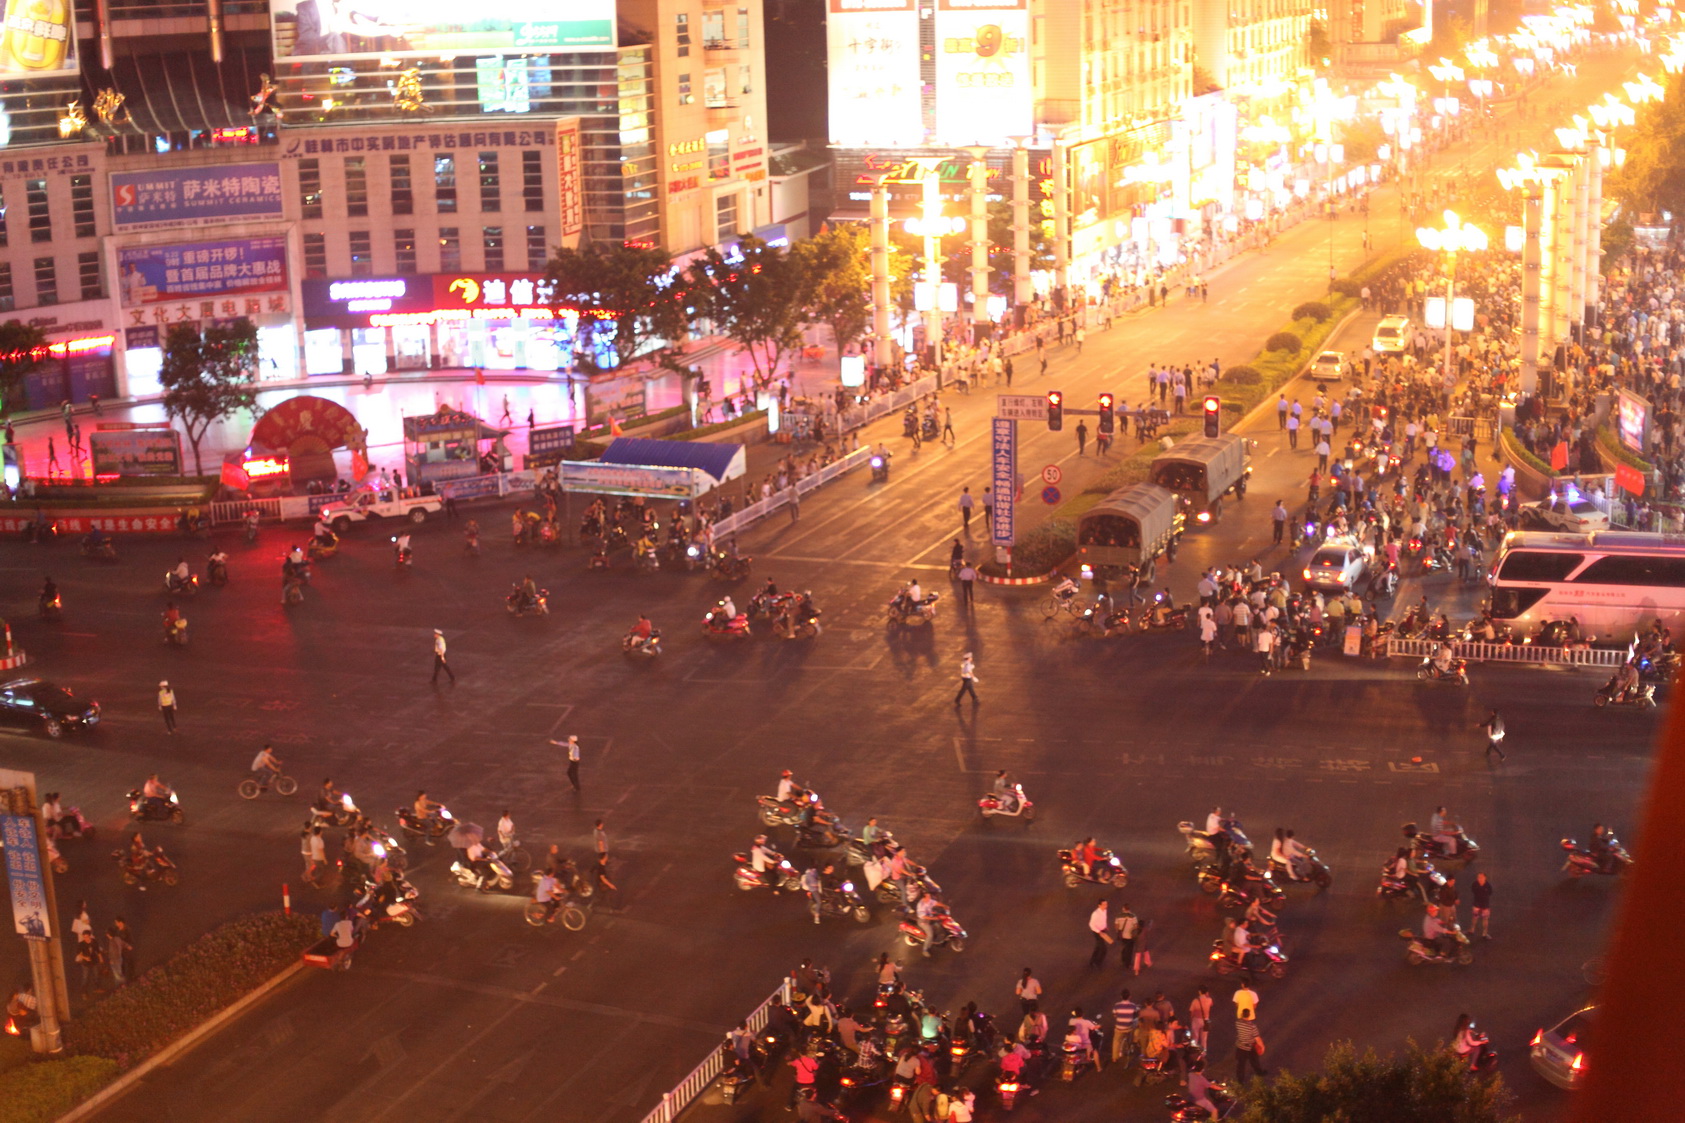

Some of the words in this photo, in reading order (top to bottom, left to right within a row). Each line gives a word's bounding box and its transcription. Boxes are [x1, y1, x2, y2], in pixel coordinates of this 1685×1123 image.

[182, 175, 281, 200] 萨米特陶瓷
[138, 190, 177, 206] 萨米特
[183, 198, 224, 207] SUMMIT
[229, 194, 281, 204] CERAMICS
[165, 259, 281, 283] 暨首届品牌大惠战
[130, 295, 286, 325] 文化大厦电脑城
[1047, 469, 1058, 480] 50
